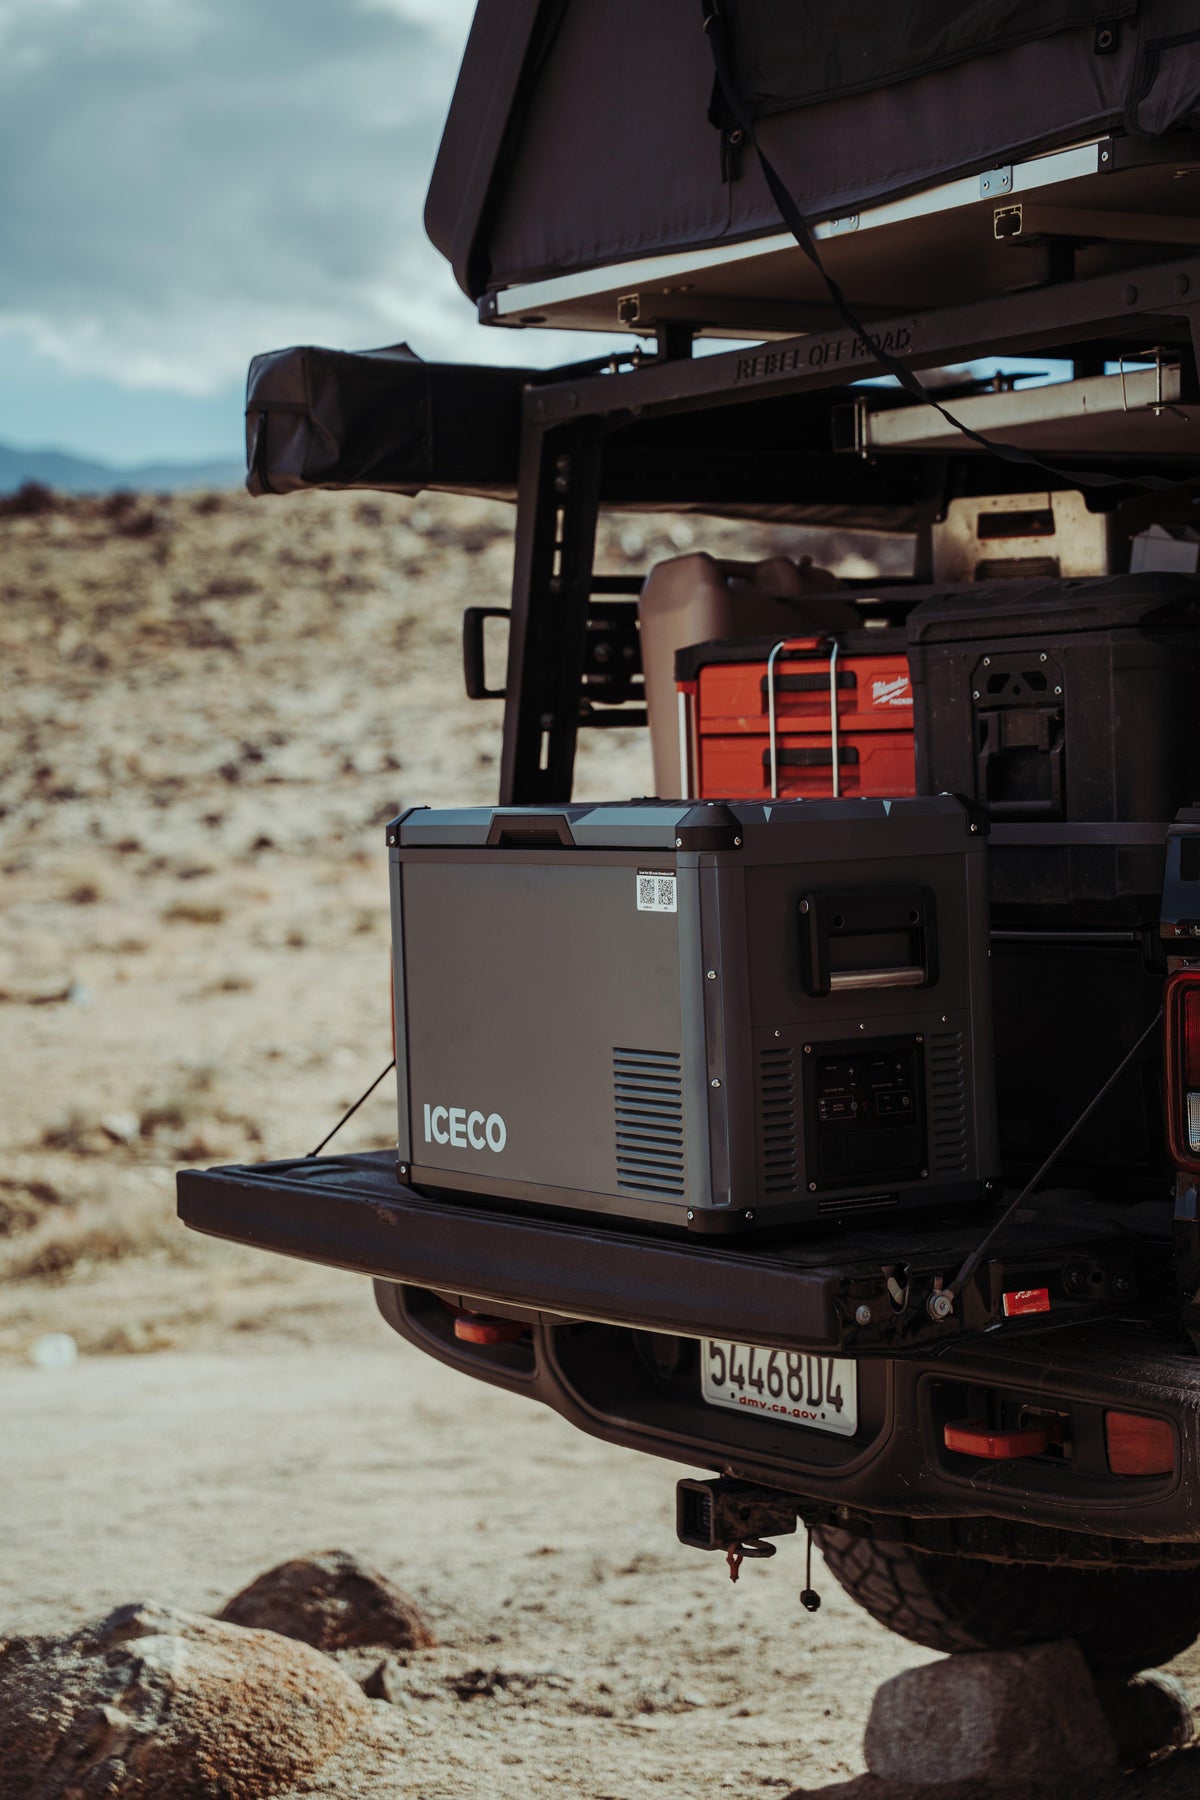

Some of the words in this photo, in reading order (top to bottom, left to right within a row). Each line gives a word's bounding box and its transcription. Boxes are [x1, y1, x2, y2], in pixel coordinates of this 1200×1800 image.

[735, 349, 804, 380] REBEL
[809, 338, 848, 367] OFF
[423, 1103, 507, 1153] ICECO
[709, 1341, 843, 1413] 54468D4
[739, 1396, 818, 1420] dmv.ca.gov
